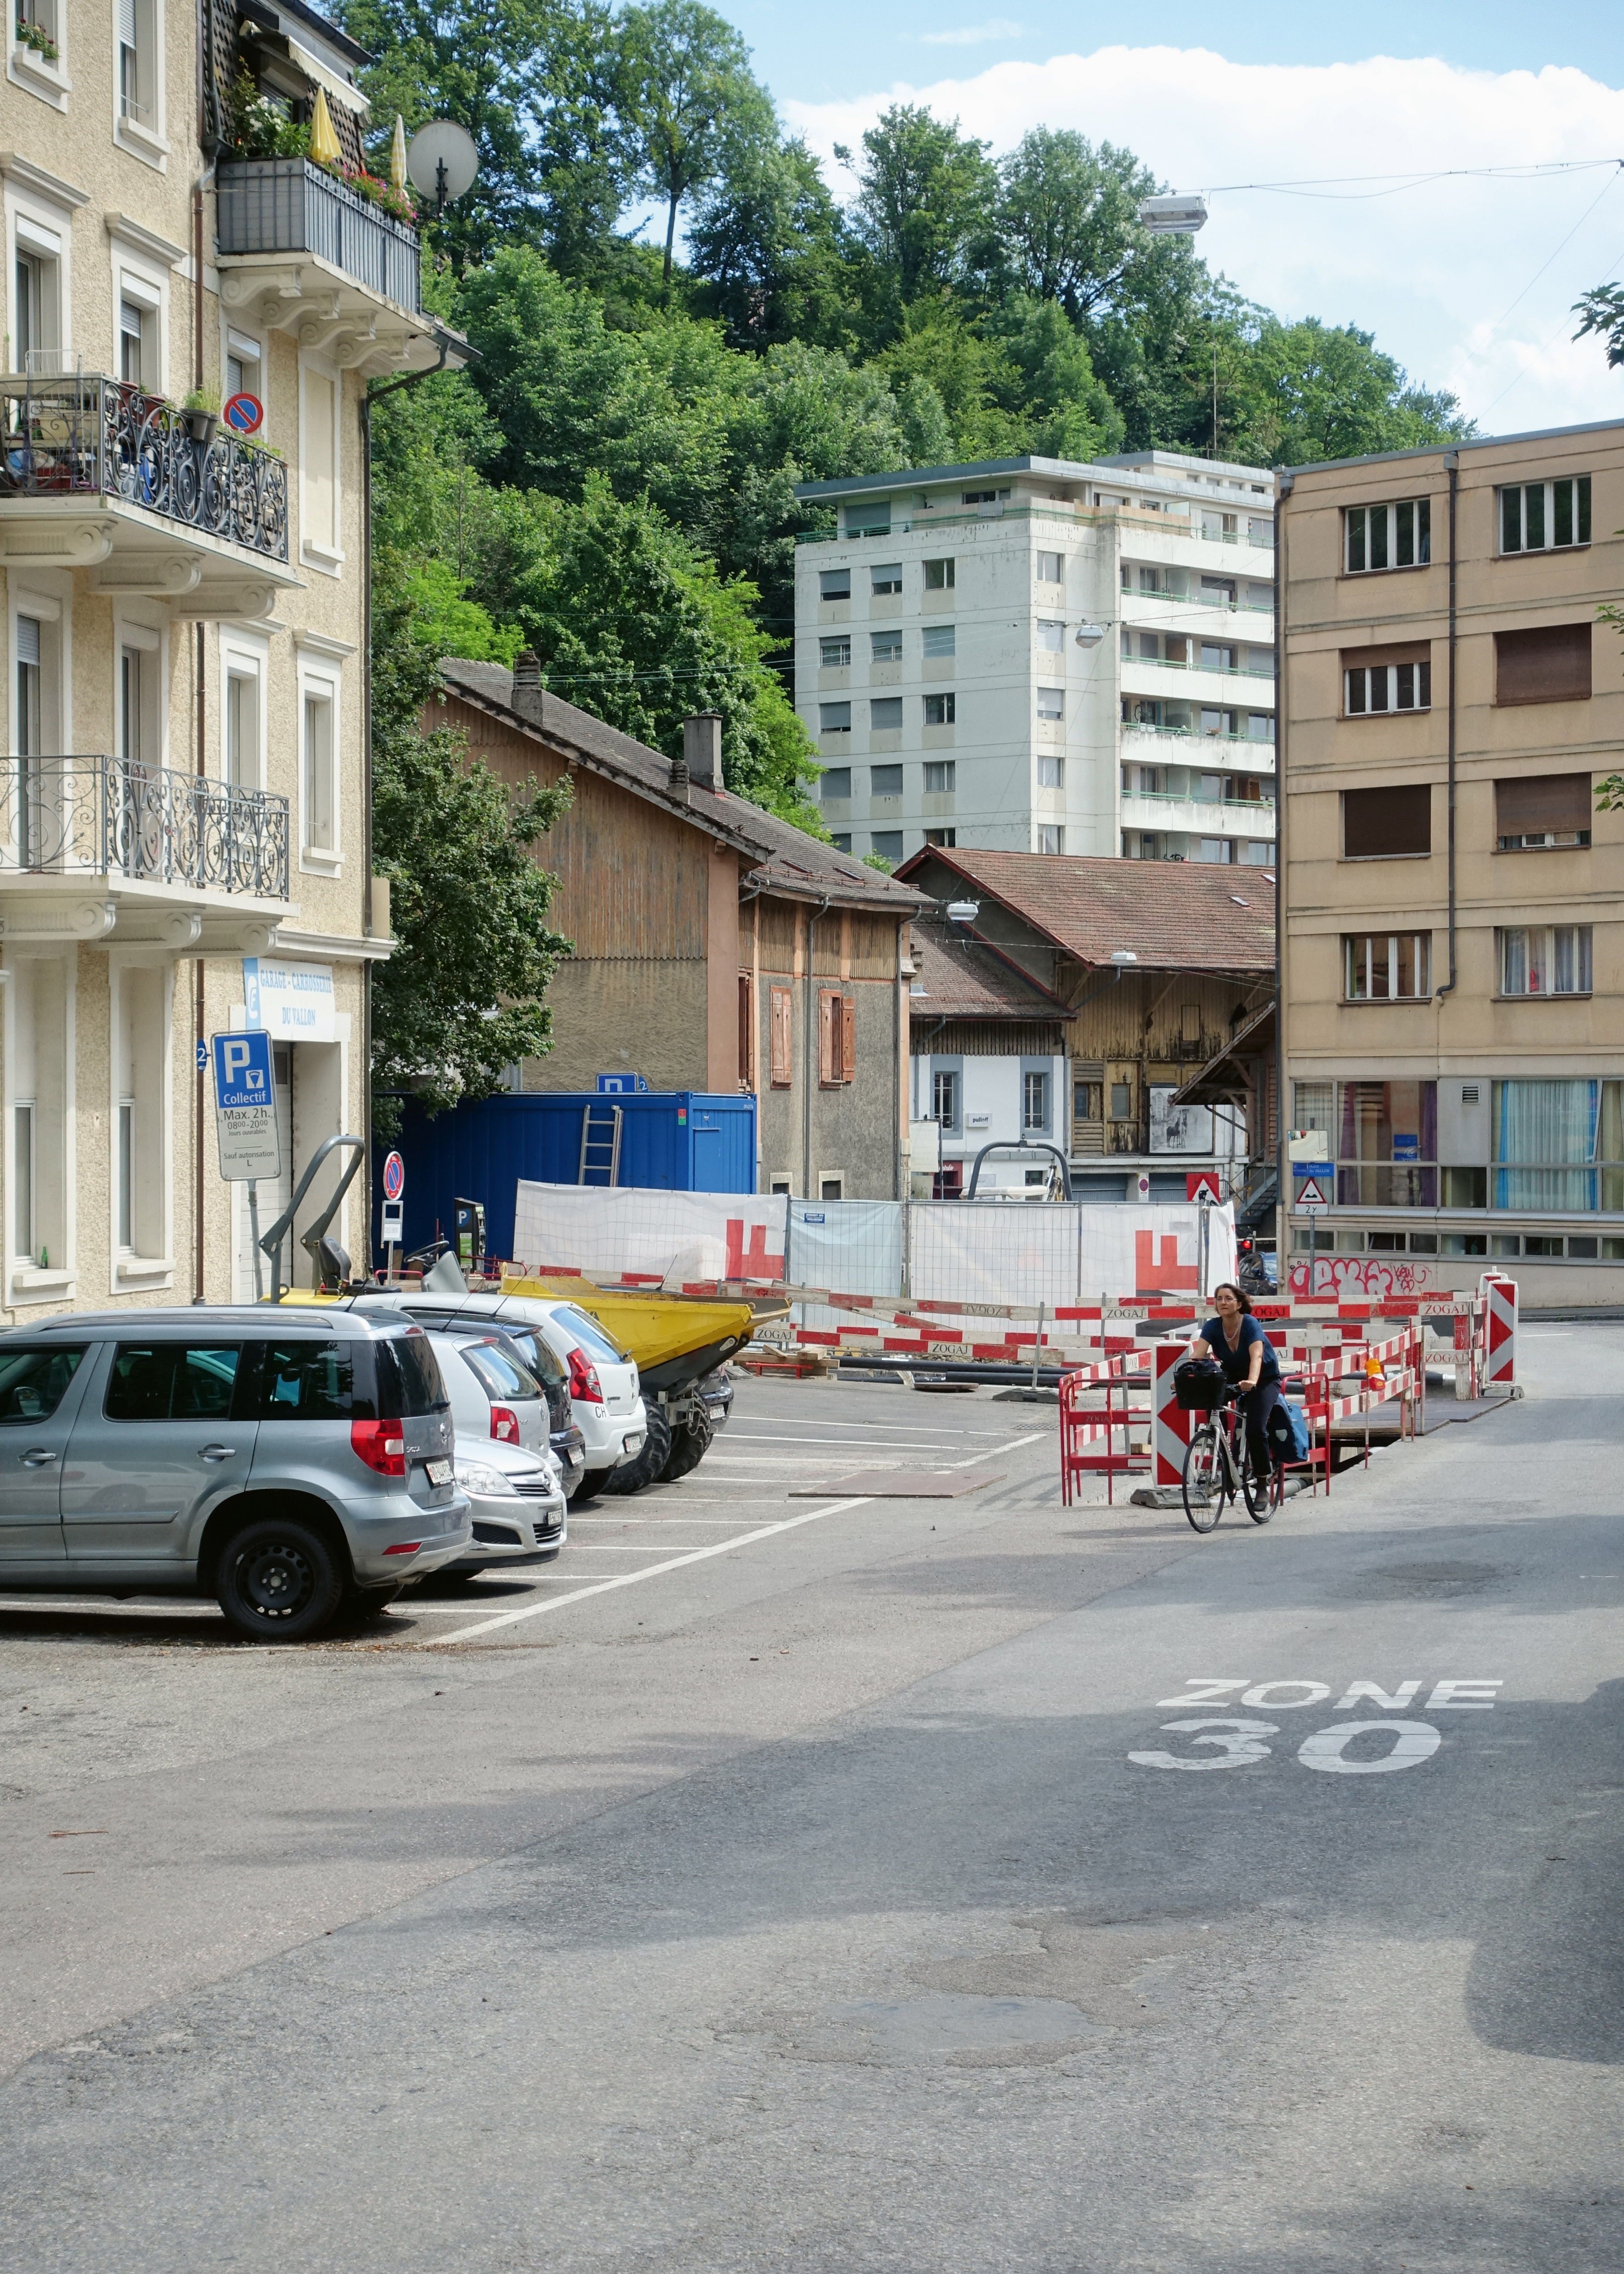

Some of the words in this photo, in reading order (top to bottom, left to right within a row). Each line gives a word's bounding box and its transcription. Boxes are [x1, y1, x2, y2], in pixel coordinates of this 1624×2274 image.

[260, 969, 286, 989] GARAGE
[292, 972, 332, 993] CARROSSERIE
[282, 1007, 290, 1025] DU
[292, 1008, 316, 1026] VALLON
[197, 1048, 206, 1062] 2
[223, 1040, 250, 1083] P
[223, 1090, 266, 1104] Collectif
[224, 1110, 250, 1120] Max.
[238, 1150, 274, 1159] autorisation
[459, 1211, 467, 1224] P
[966, 1305, 1002, 1316] ZOGAJ
[1107, 1309, 1143, 1318] ZOGAJ
[1425, 1304, 1464, 1314] ZOGAJ
[757, 1329, 792, 1340] ZOGAJ
[932, 1343, 968, 1354] ZOGAJ
[1425, 1353, 1464, 1363] ZOGAJ
[595, 1406, 606, 1418] CH
[1156, 1679, 1503, 1709] ZONE
[1127, 1718, 1441, 1773] 30
